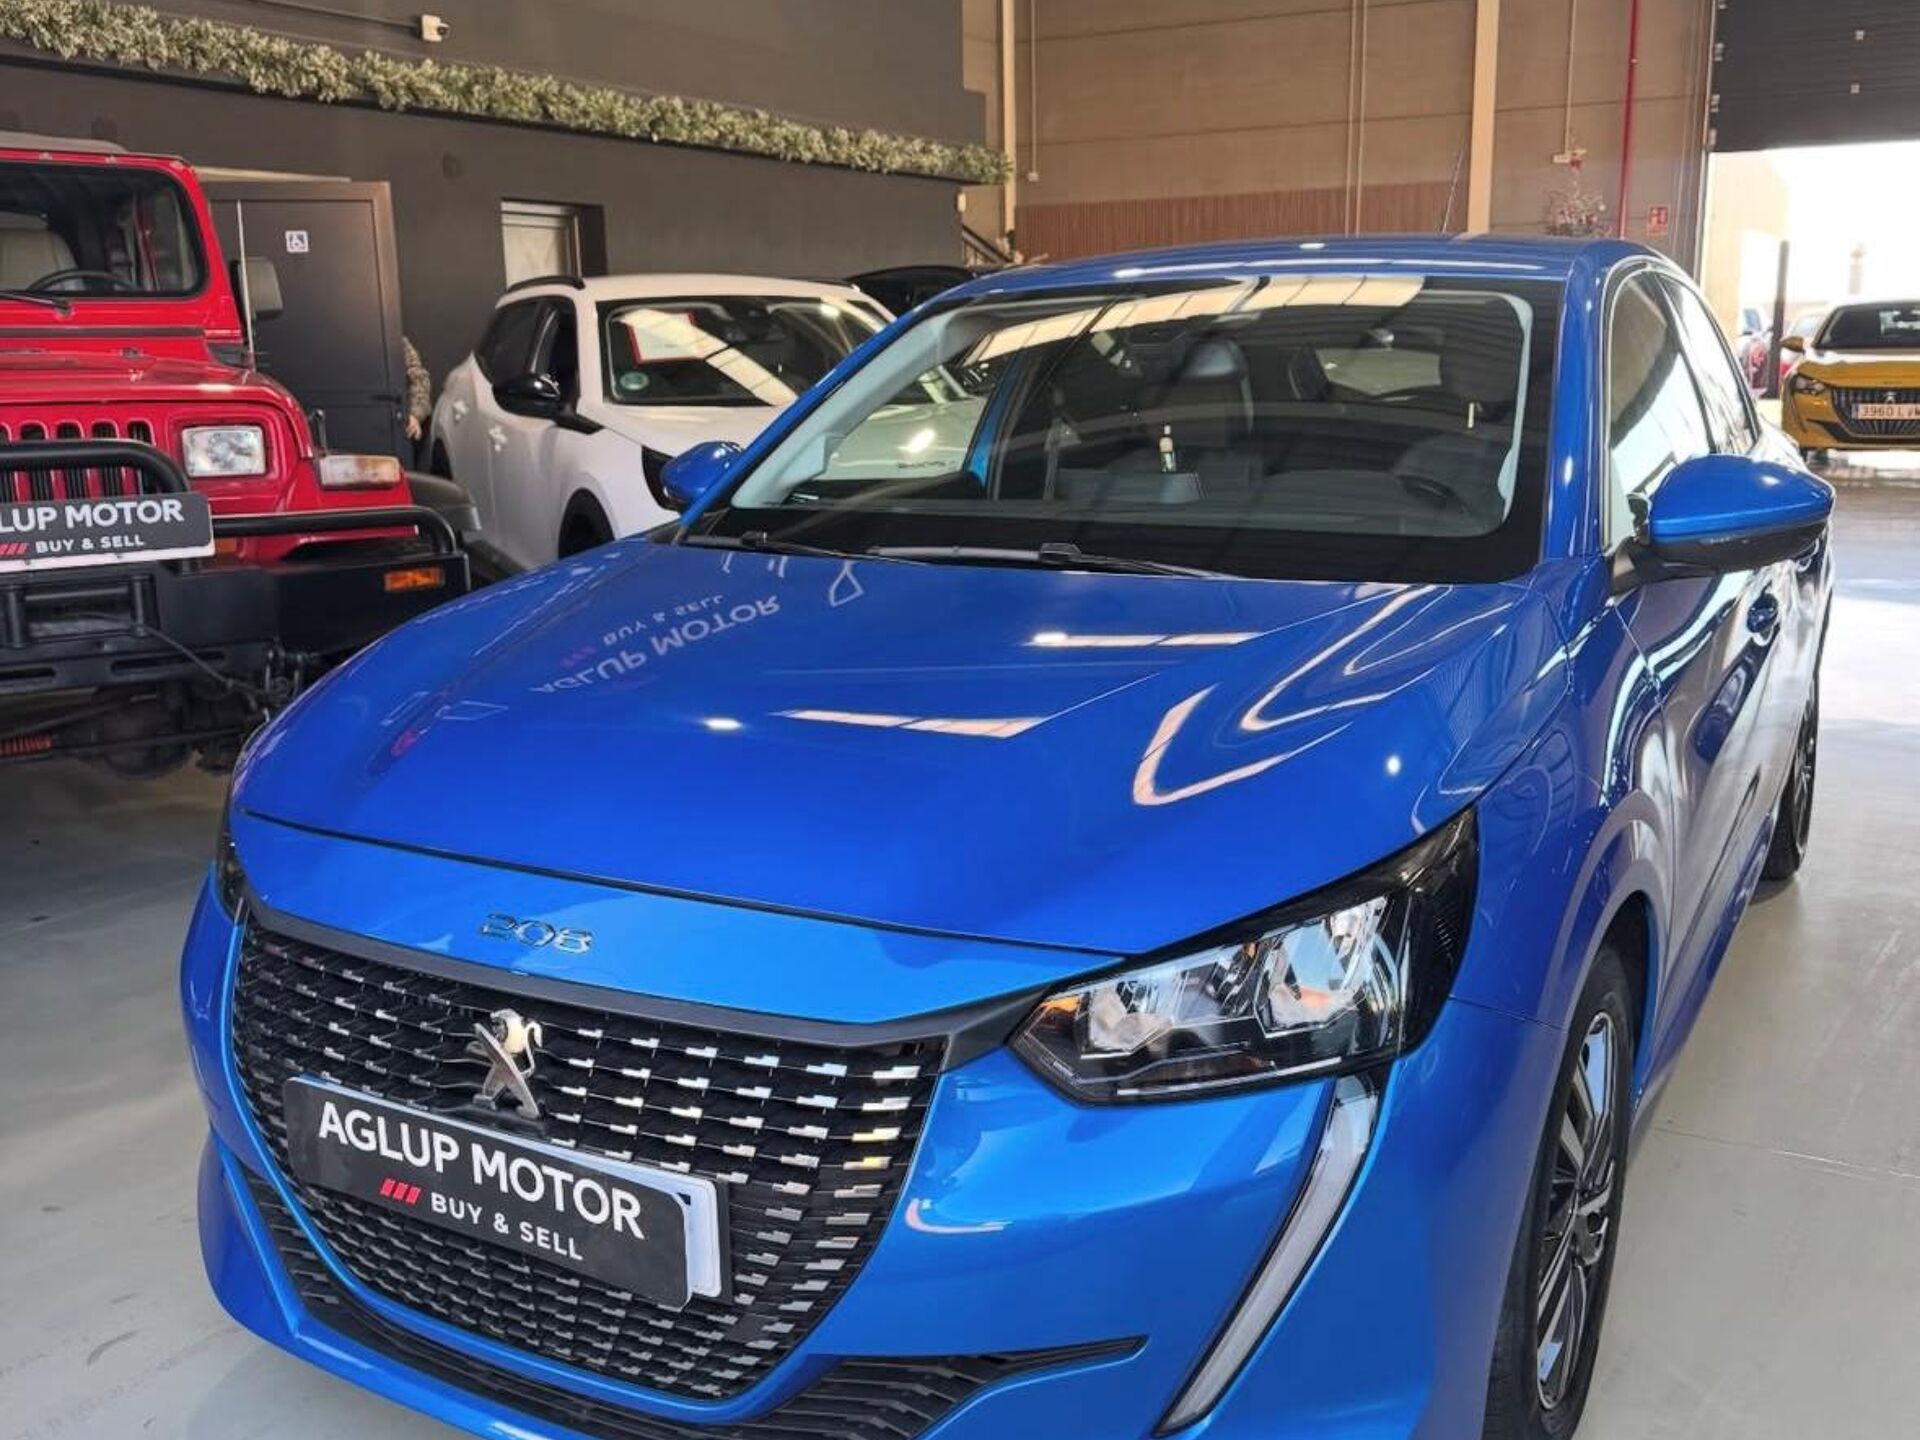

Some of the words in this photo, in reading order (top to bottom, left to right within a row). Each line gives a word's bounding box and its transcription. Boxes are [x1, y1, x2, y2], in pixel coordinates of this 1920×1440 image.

[65, 499, 184, 529] MOTOR
[35, 539, 74, 554] BUY
[81, 537, 94, 550] &
[100, 534, 144, 549] SELL
[479, 913, 593, 955] 208
[318, 1102, 461, 1173] AGLUP
[471, 1143, 645, 1240] MOTOR
[430, 1192, 483, 1225] BUY
[493, 1213, 509, 1235] &
[519, 1221, 583, 1261] SELL
